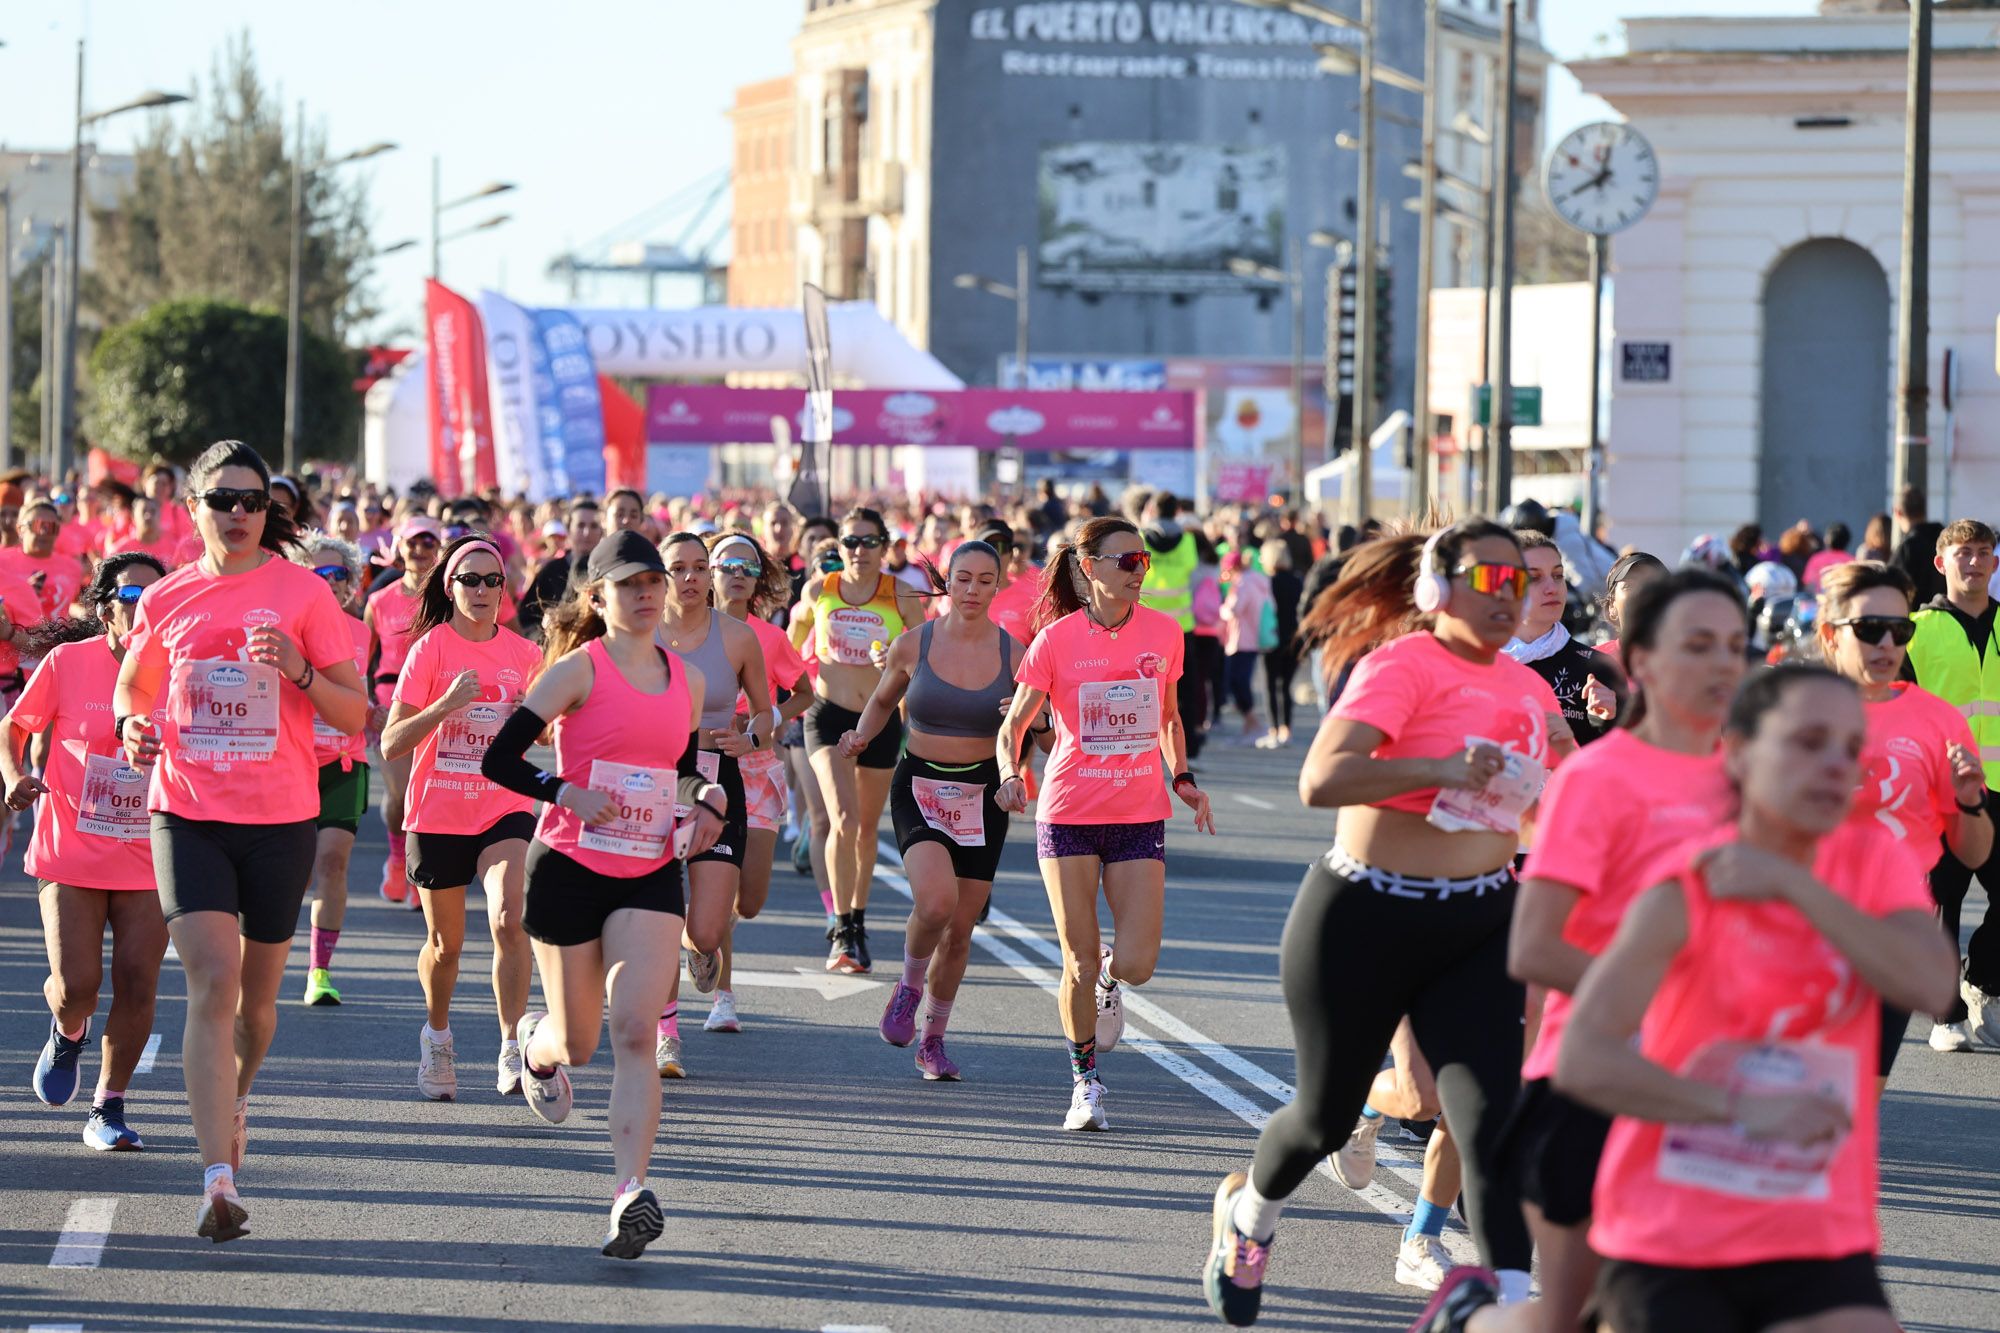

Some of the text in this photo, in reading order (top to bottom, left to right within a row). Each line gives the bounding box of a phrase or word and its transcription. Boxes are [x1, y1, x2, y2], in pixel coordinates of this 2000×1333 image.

[1013, 1, 1143, 43] PUERTO
[1002, 51, 1187, 79] Restaurante
[584, 320, 777, 362] OYSHO
[834, 611, 880, 623] Serrano
[844, 647, 867, 659] 016
[1074, 658, 1109, 669] OYSHO
[210, 673, 245, 683] ASTURIANA
[1107, 690, 1134, 699] ASTURIANA
[85, 702, 113, 712] OYSH
[210, 702, 248, 717] 016
[468, 712, 497, 721] ASTURIANA
[1108, 713, 1138, 726] 016
[187, 736, 218, 746] OYSHO
[444, 761, 471, 769] OYSHO
[1078, 767, 1112, 779] CARRERA
[1113, 769, 1123, 779] DE
[428, 778, 462, 791] CARRERA
[464, 782, 475, 791] DE
[476, 782, 487, 792] LA
[111, 795, 142, 808] 016
[464, 792, 479, 800] 2025
[115, 811, 132, 819] 6602
[621, 806, 653, 823] 016
[937, 808, 961, 821] 016
[86, 821, 114, 832] OYSHO
